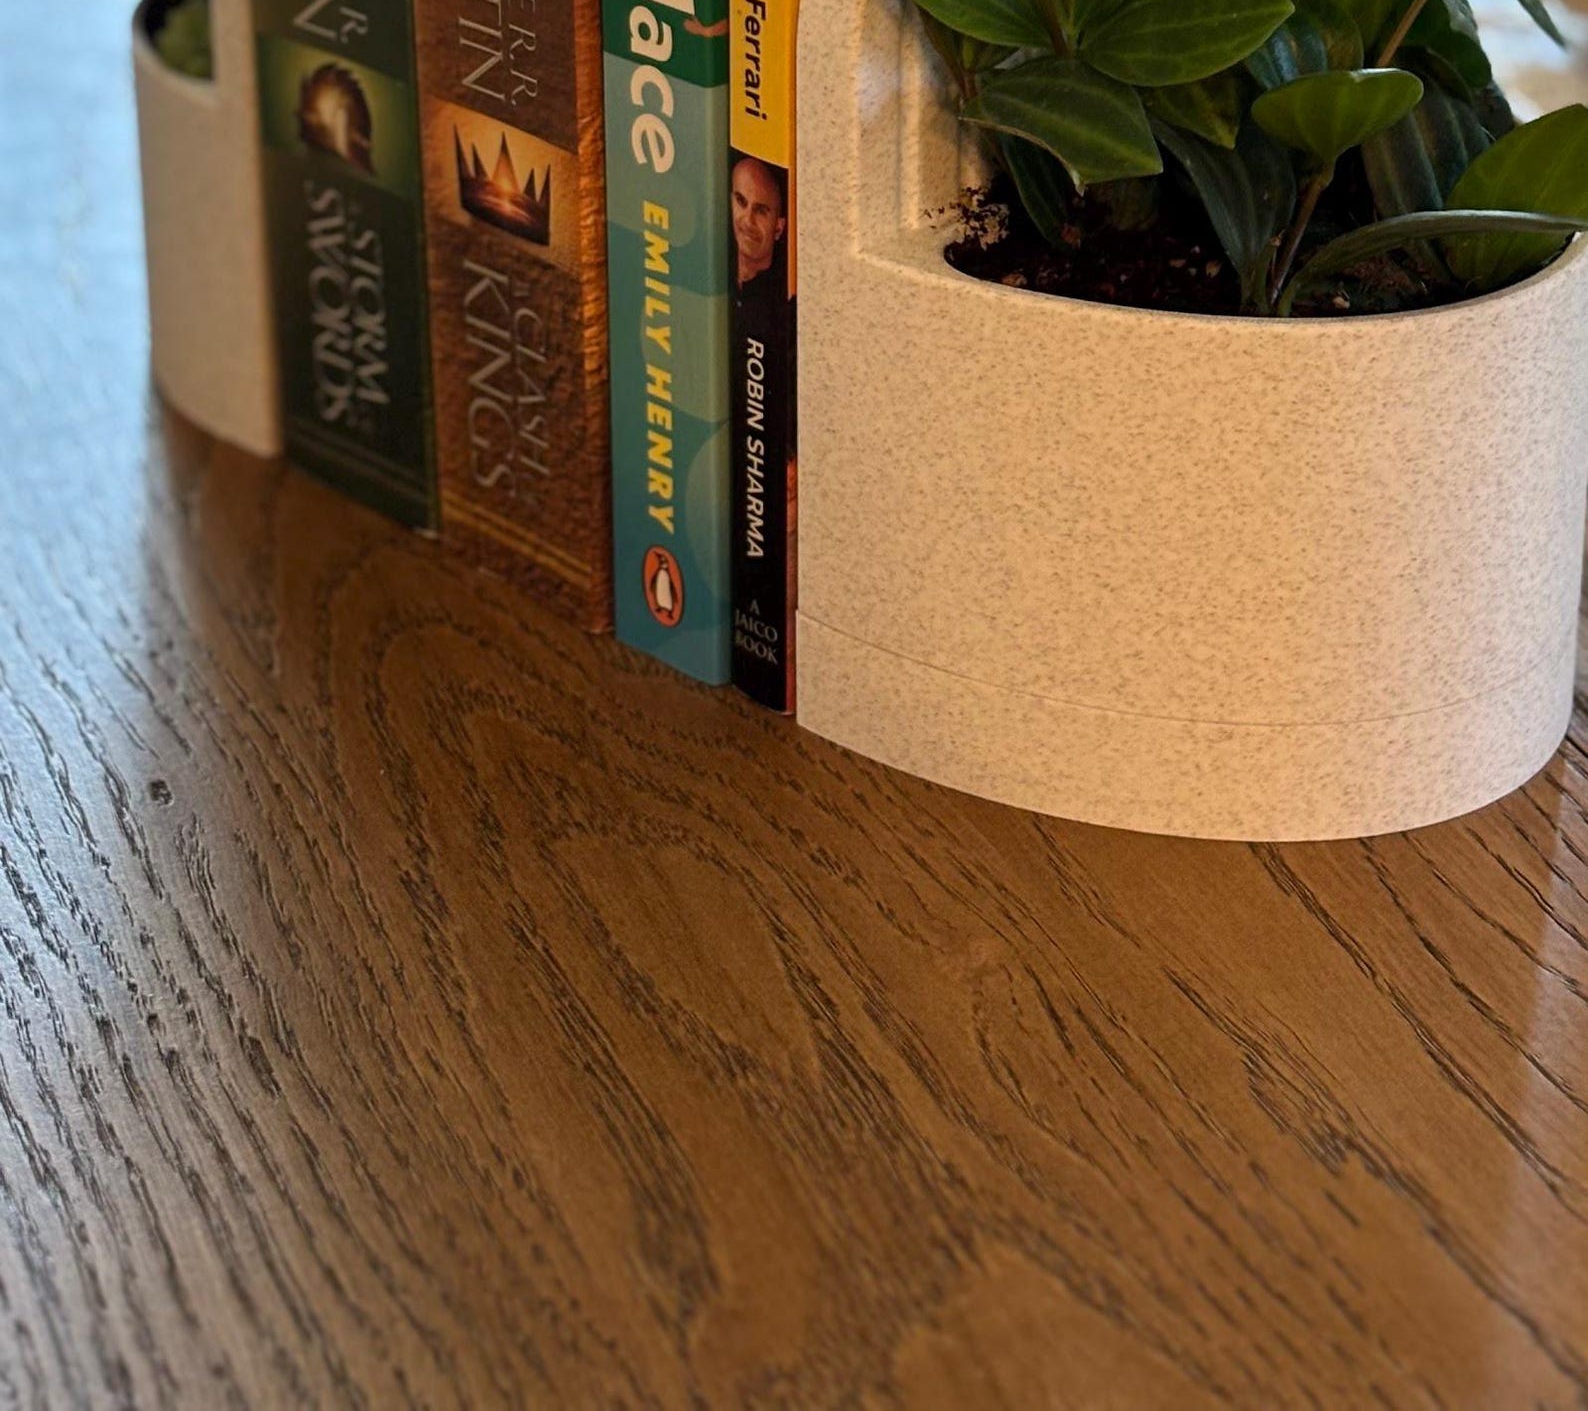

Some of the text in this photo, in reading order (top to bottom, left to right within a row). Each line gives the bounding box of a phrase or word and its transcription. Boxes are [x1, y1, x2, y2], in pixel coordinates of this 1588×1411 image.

[303, 180, 352, 424] SWORDS
[351, 227, 390, 406] STORM
[463, 258, 518, 499] KINGS
[642, 199, 675, 536] EMILY HENRY
[513, 306, 551, 478] CLASH
[745, 336, 765, 559] ROBIN SHARMA
[735, 608, 778, 643] JAICO
[735, 629, 778, 666] BOOK
[749, 598, 761, 617] A
